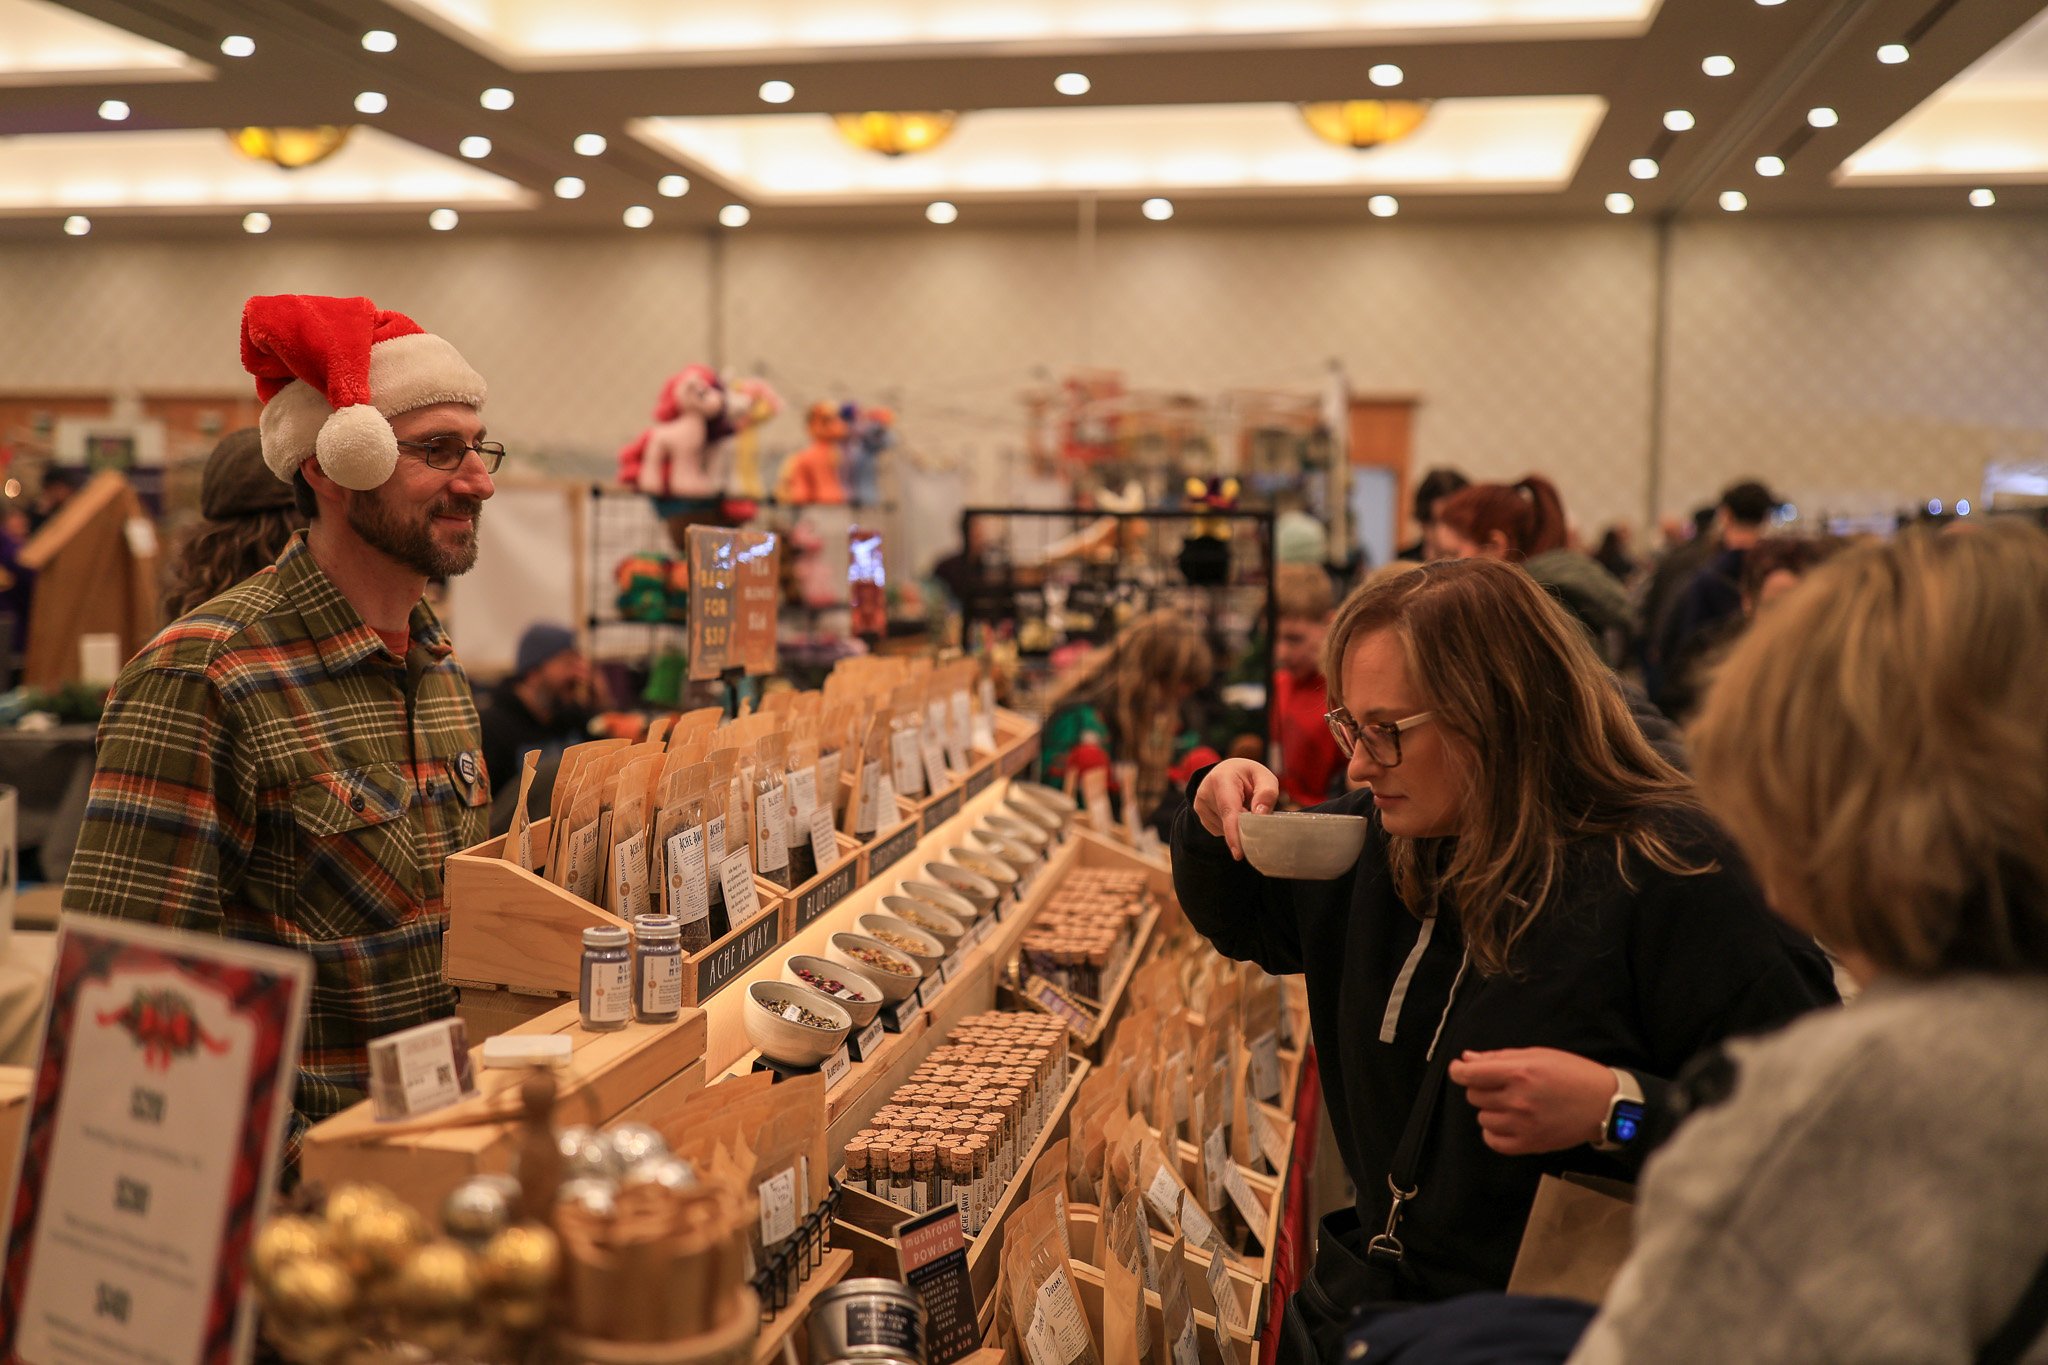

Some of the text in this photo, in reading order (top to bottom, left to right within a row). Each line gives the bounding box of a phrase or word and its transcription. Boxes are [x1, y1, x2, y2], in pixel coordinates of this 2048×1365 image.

[571, 835, 579, 870] BOTANICA
[671, 840, 679, 874] BOTANICA
[679, 834, 694, 853] ACHE
[709, 921, 769, 986] ACHE AWAY
[962, 1192, 970, 1213] AWAY
[905, 1218, 957, 1248] mushroom
[943, 1269, 958, 1280] MANE
